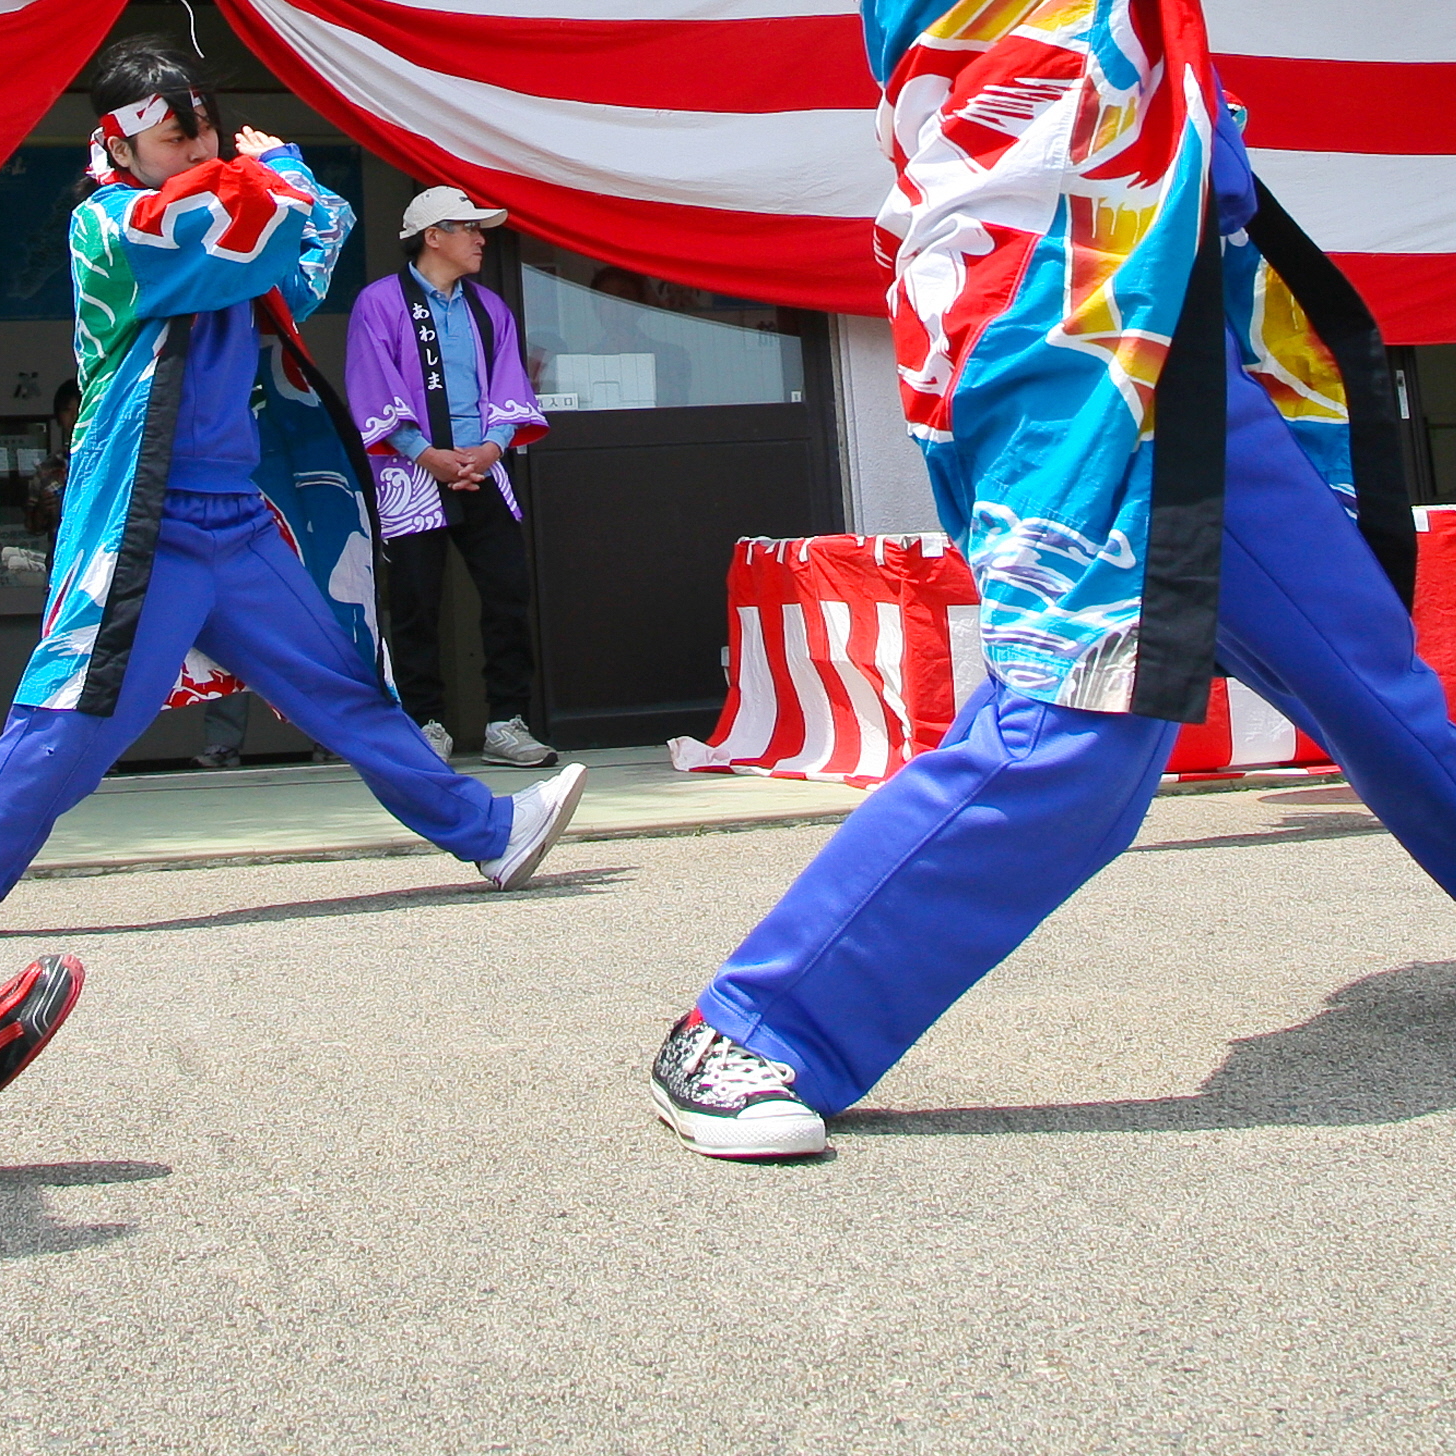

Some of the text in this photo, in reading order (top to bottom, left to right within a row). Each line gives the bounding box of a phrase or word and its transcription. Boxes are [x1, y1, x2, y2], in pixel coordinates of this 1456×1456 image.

[412, 302, 444, 391] あわしま
[539, 397, 573, 408] 入口
